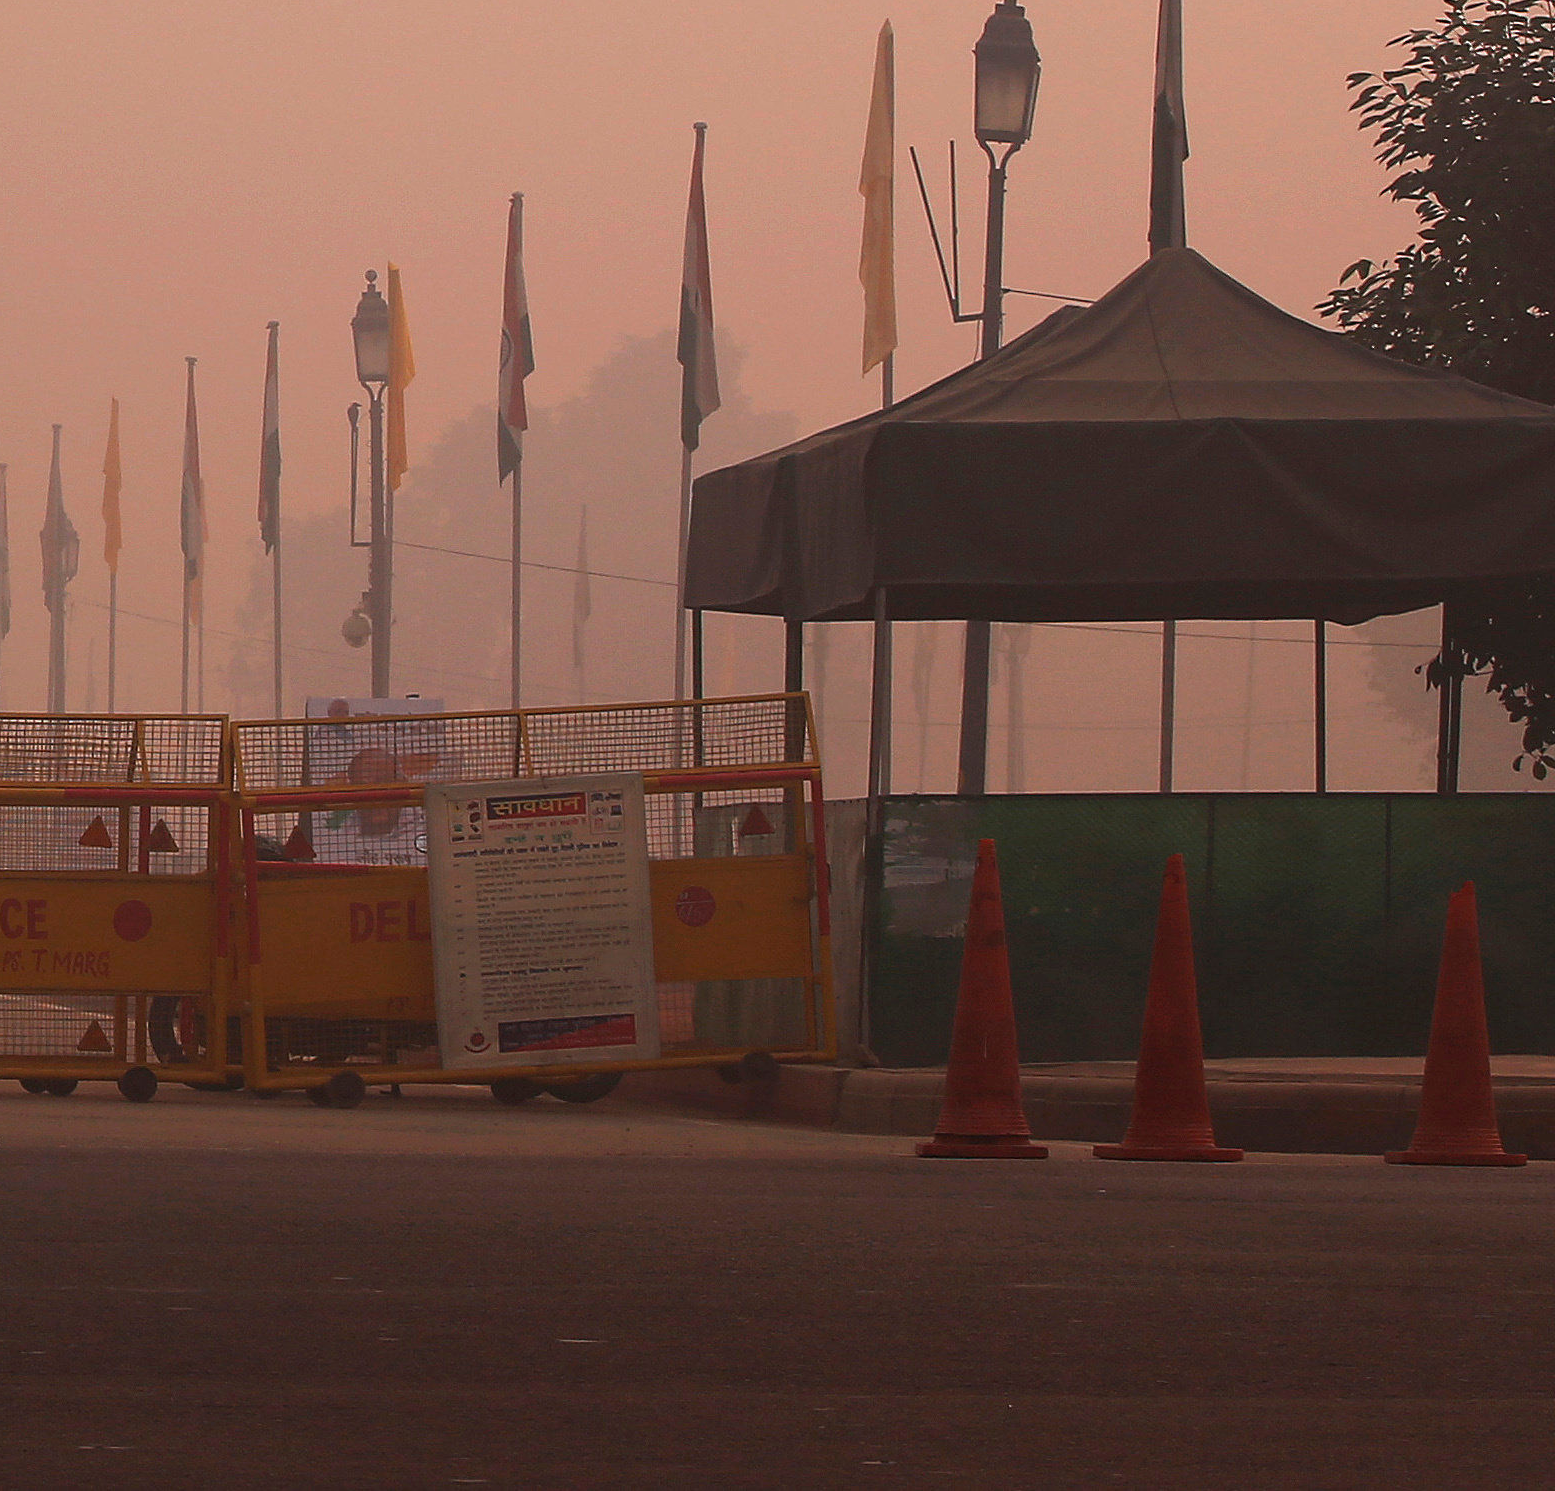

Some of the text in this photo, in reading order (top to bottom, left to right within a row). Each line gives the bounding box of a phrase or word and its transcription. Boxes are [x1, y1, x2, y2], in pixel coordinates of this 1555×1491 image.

[491, 795, 583, 817] सावधान
[349, 899, 432, 944] DEL
[53, 950, 112, 978] MARG
